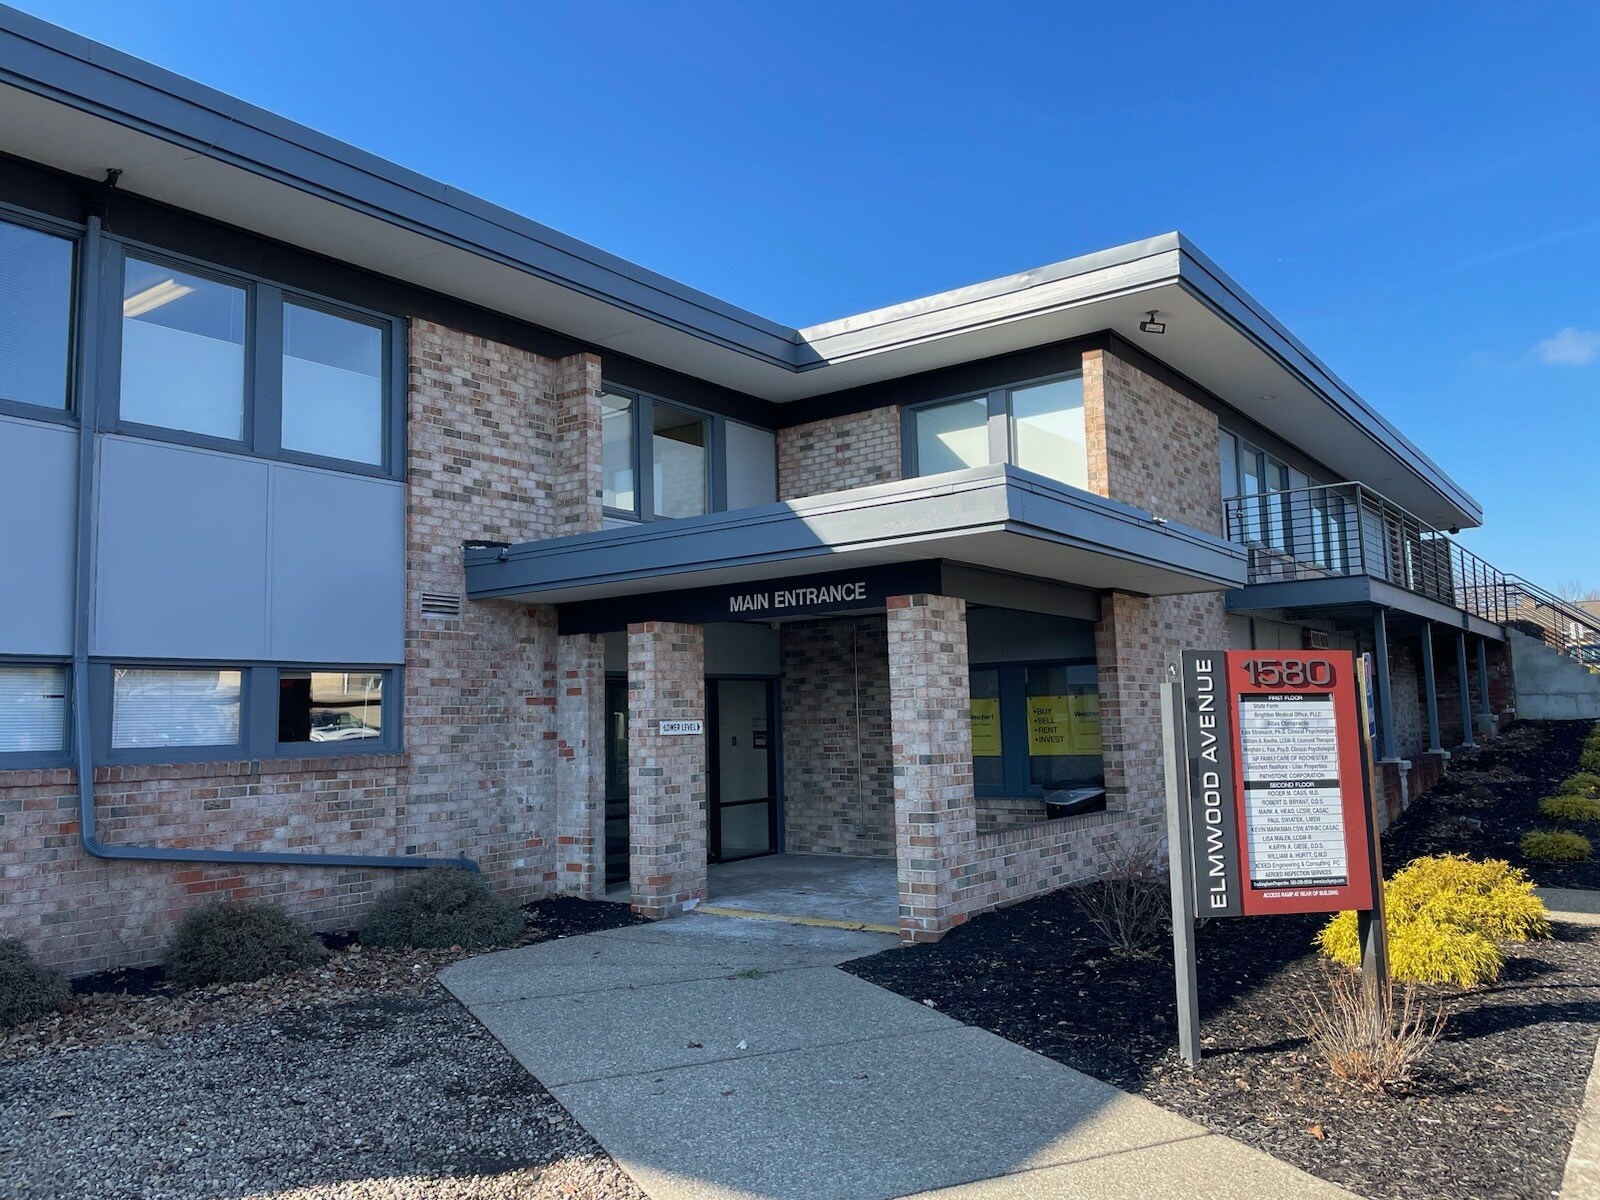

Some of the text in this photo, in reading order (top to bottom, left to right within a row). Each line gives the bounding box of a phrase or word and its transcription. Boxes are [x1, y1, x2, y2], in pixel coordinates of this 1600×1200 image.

[730, 582, 866, 612] MAIN ENTRANCE
[1241, 658, 1331, 686] 1580
[664, 723, 696, 732] LOWER LEVEL
[1196, 659, 1228, 908] ELMWOOD AVENUE
